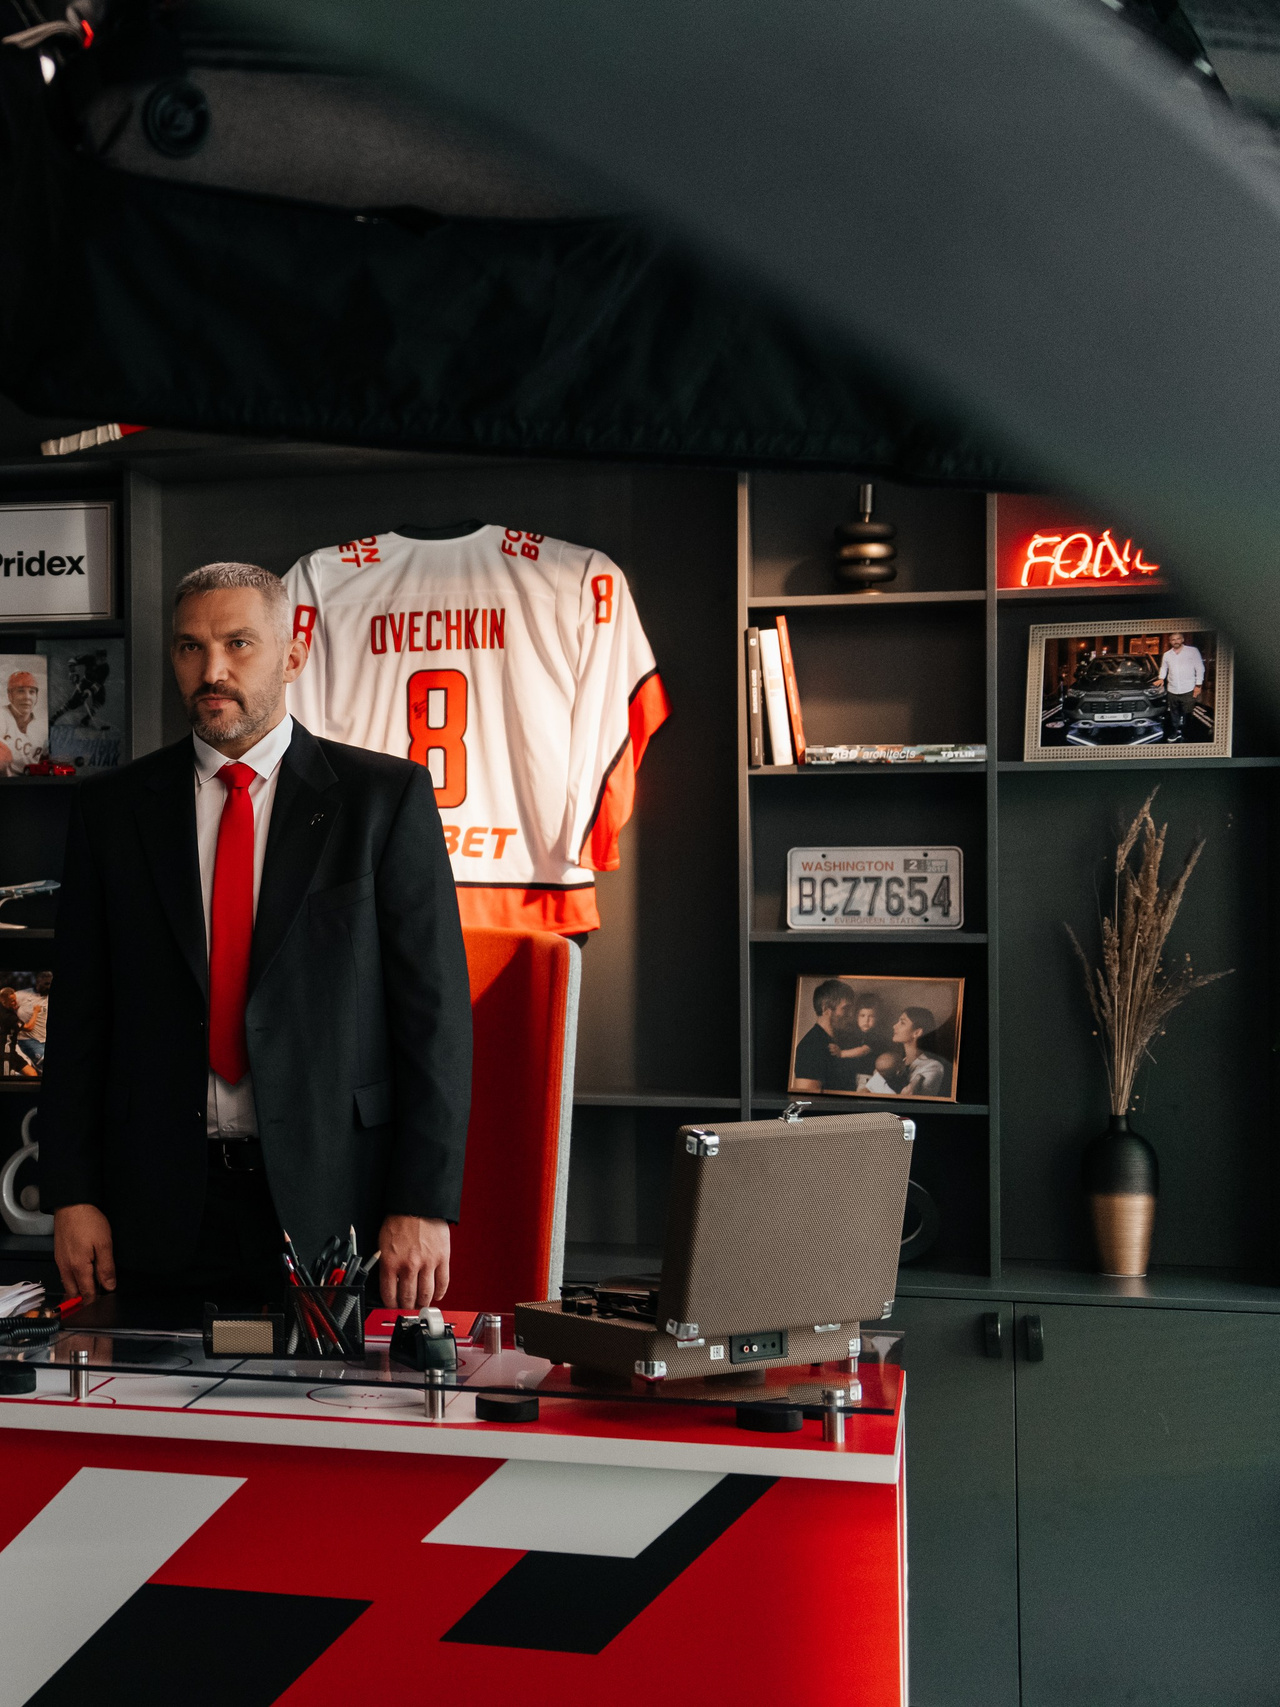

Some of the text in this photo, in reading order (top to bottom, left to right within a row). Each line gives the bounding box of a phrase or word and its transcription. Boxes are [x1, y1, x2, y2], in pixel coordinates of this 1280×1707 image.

[591, 574, 613, 624] 8
[370, 608, 506, 655] OVECHKIN
[406, 668, 468, 808] 8
[862, 748, 917, 760] architects
[801, 860, 895, 872] WASHINGTON
[909, 860, 918, 870] 2
[798, 875, 952, 918] BCZ7654
